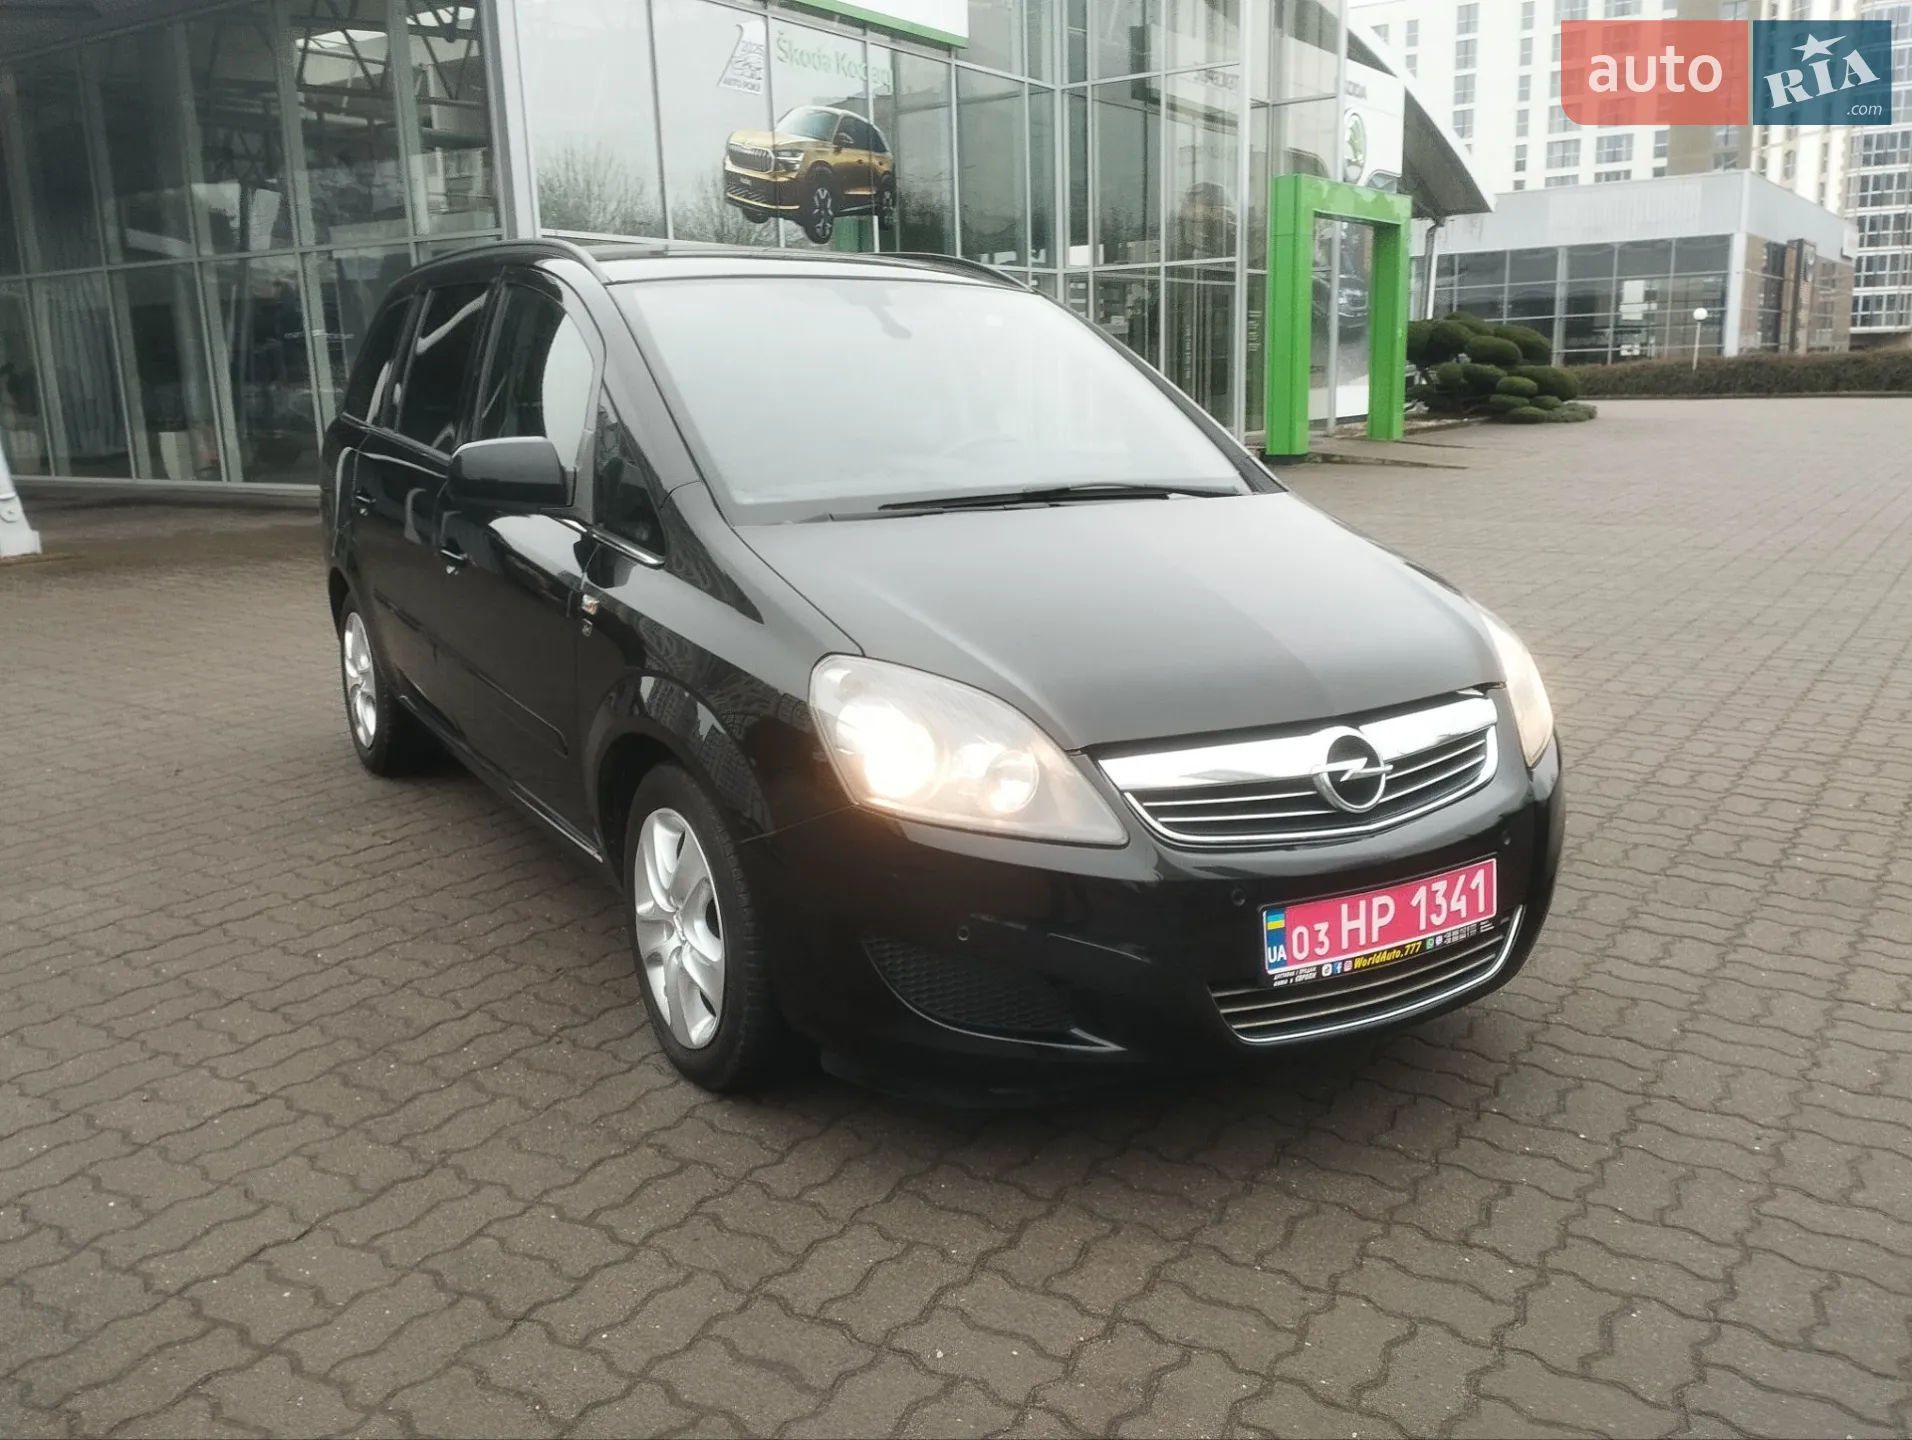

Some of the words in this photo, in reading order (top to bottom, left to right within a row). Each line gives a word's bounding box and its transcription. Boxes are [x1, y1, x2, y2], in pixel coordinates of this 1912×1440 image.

[1291, 921, 1330, 961] 03
[1340, 895, 1395, 950] HP
[1410, 868, 1486, 931] 1341
[1267, 944, 1288, 964] UA
